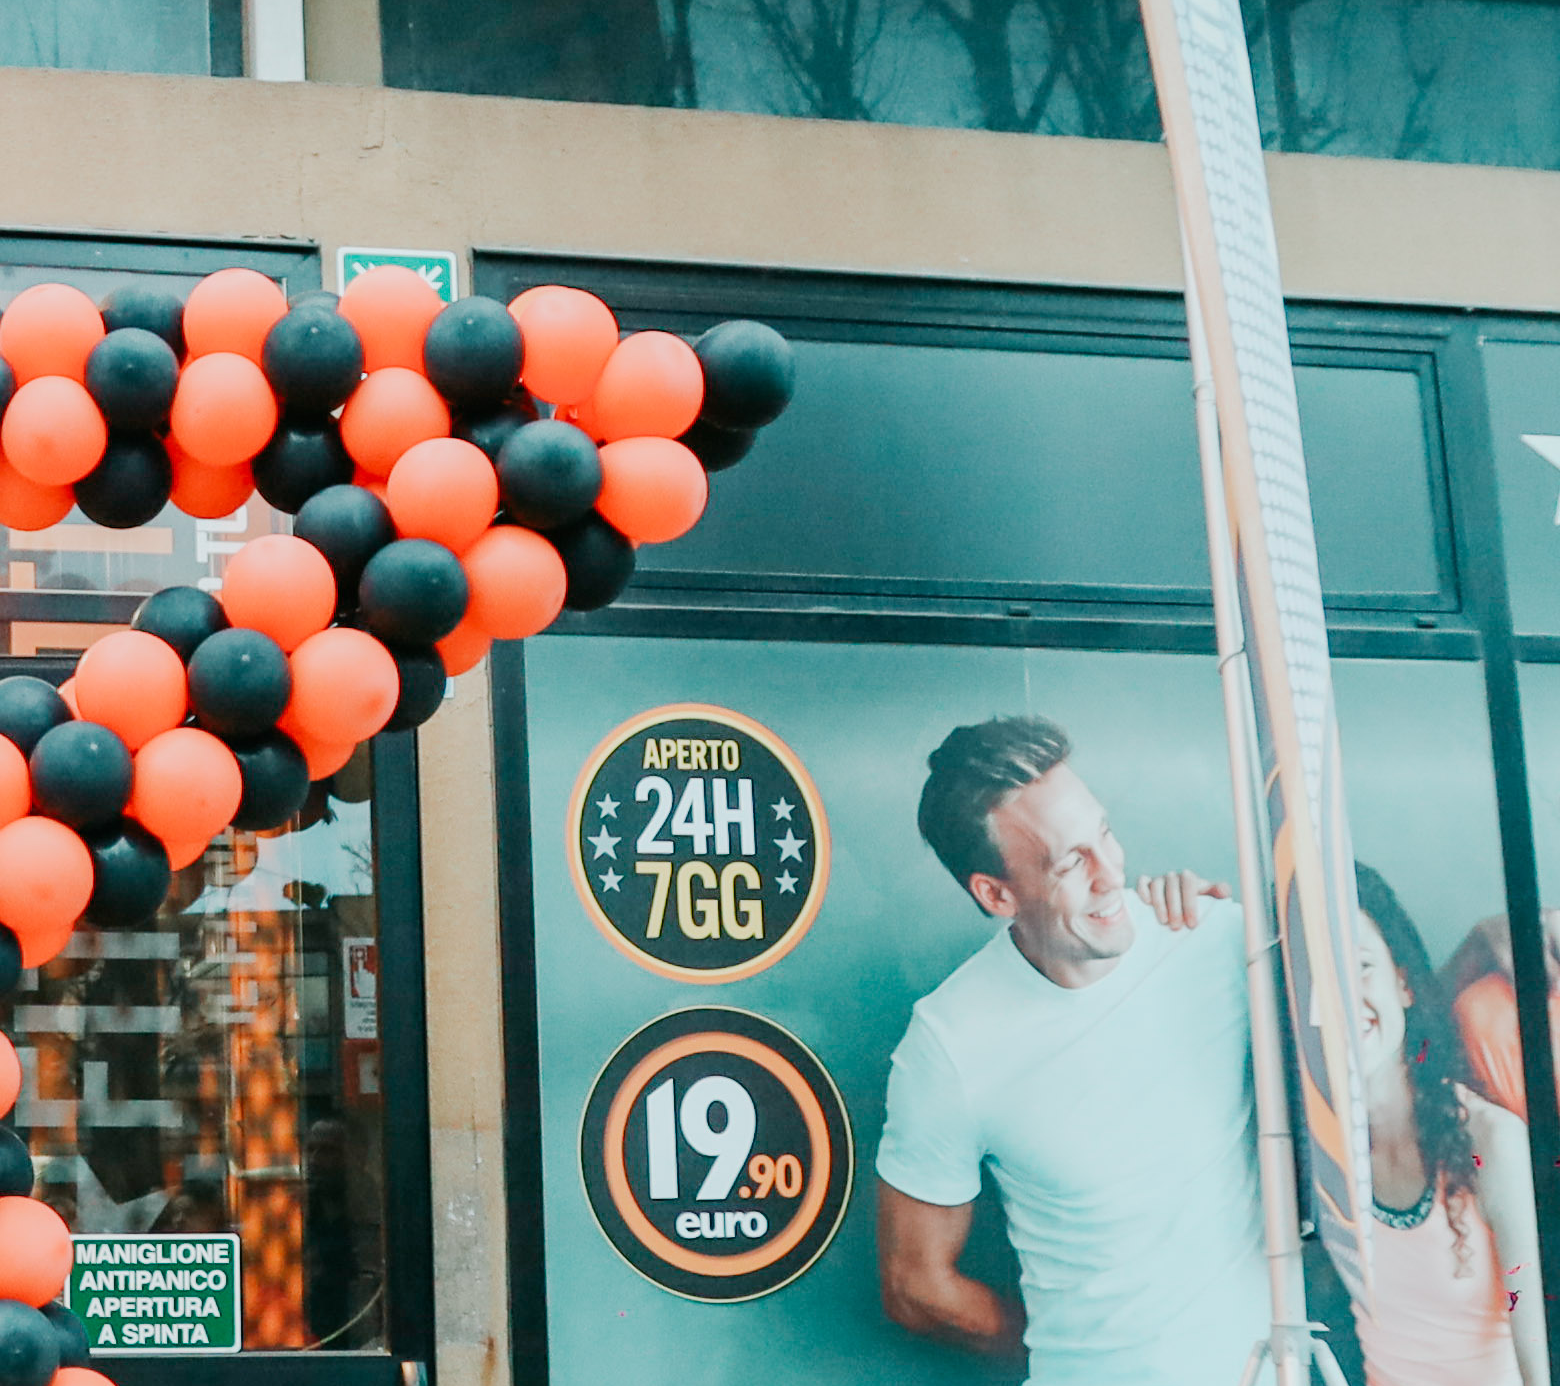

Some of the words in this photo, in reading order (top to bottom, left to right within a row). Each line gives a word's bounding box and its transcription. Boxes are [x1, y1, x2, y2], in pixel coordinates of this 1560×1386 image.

[642, 737, 740, 772] APERTO
[634, 775, 756, 857] 24H
[634, 860, 764, 941] 7GG
[675, 1210, 769, 1239] euro
[76, 1243, 230, 1264] MANIGLIONE
[79, 1269, 227, 1291] ANTIPANICO
[86, 1297, 221, 1318] APERTURA
[97, 1323, 117, 1344] A
[121, 1323, 210, 1345] SPINTA
